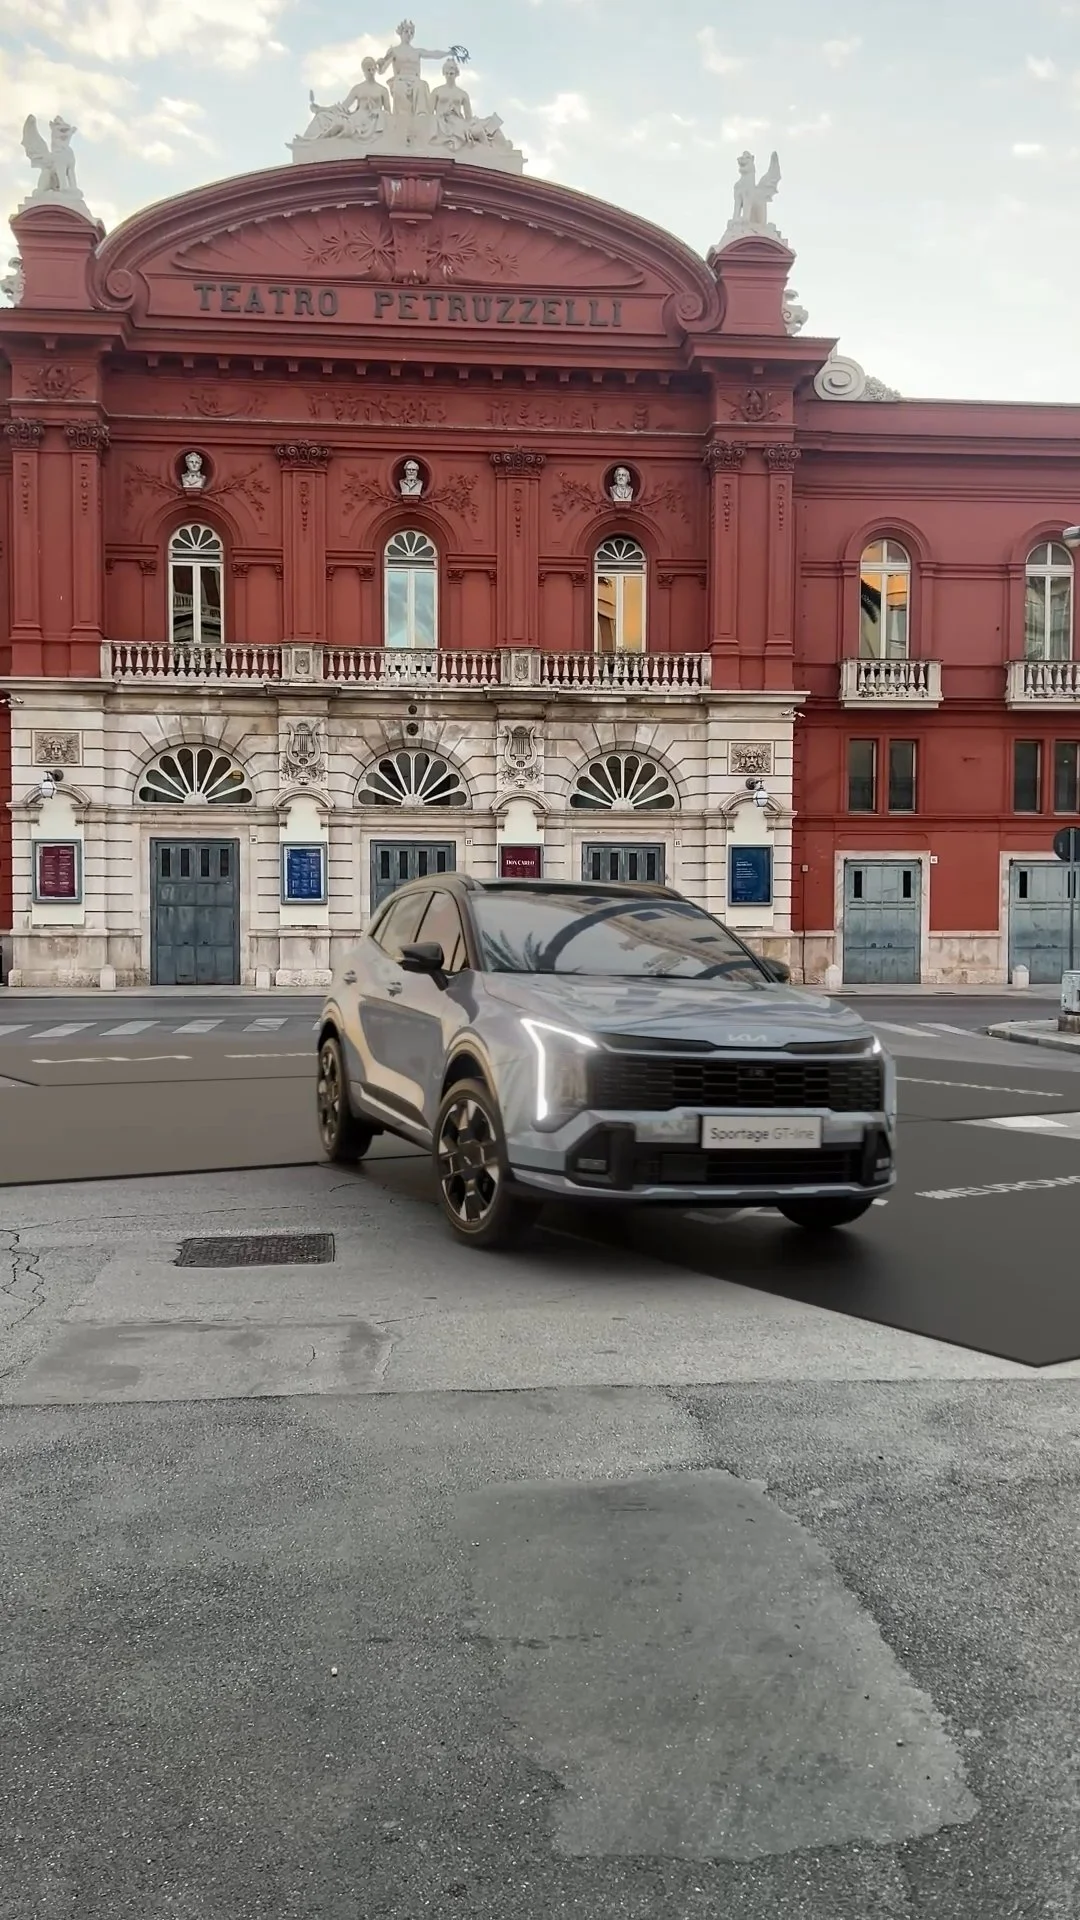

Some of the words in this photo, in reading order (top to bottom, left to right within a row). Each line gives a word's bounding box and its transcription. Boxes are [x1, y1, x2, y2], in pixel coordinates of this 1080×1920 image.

[193, 282, 339, 318] TEATRO
[372, 289, 623, 329] PETRUZZELLI
[710, 1127, 769, 1142] Sportage
[773, 1127, 815, 1140] GT-line
